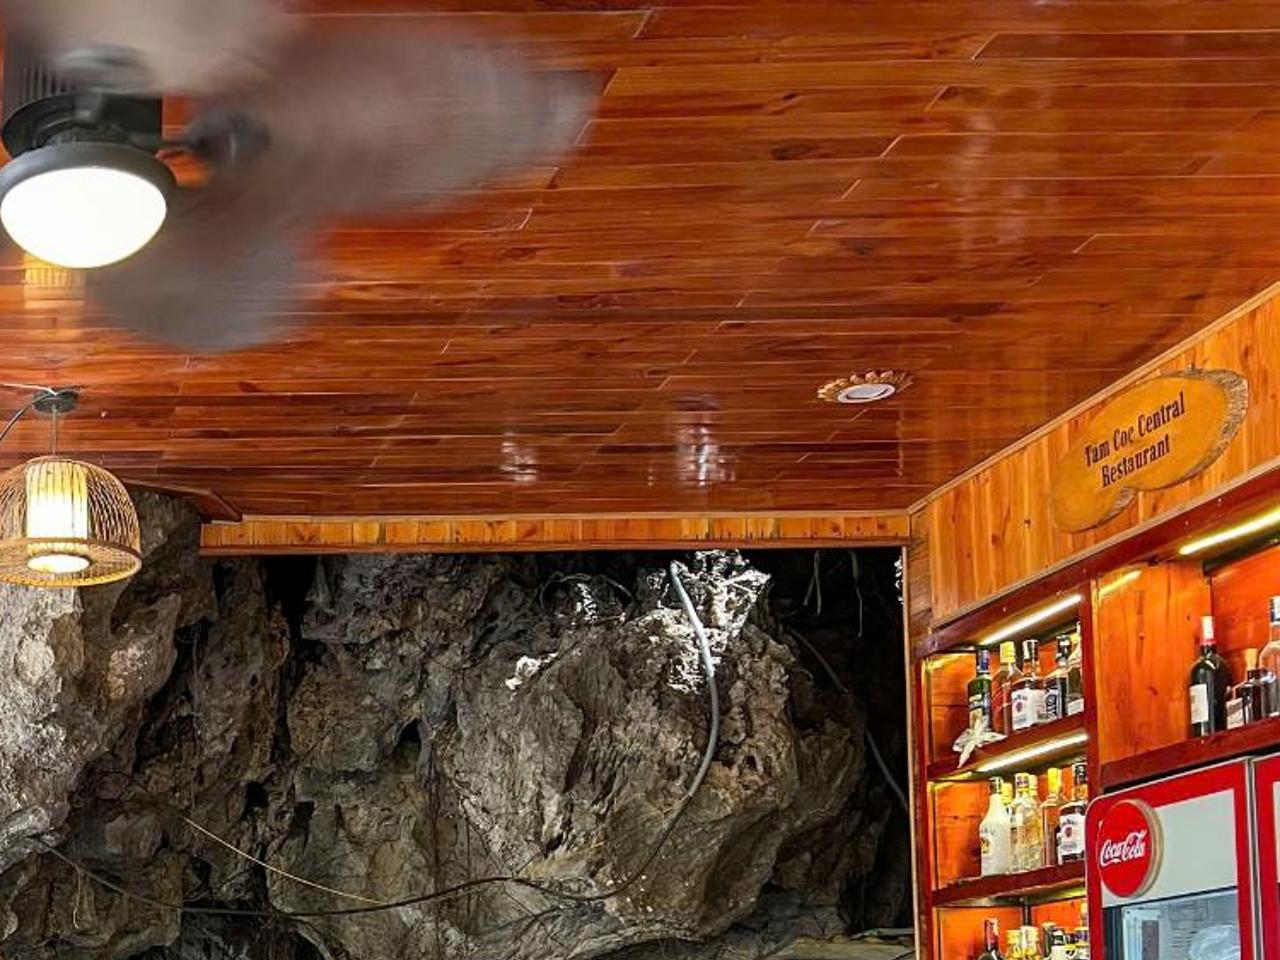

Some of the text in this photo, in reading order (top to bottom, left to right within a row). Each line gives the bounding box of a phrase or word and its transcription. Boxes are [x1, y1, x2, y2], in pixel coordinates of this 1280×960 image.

[1084, 392, 1185, 467] Tam Coc Central
[1101, 434, 1171, 488] Restaurant
